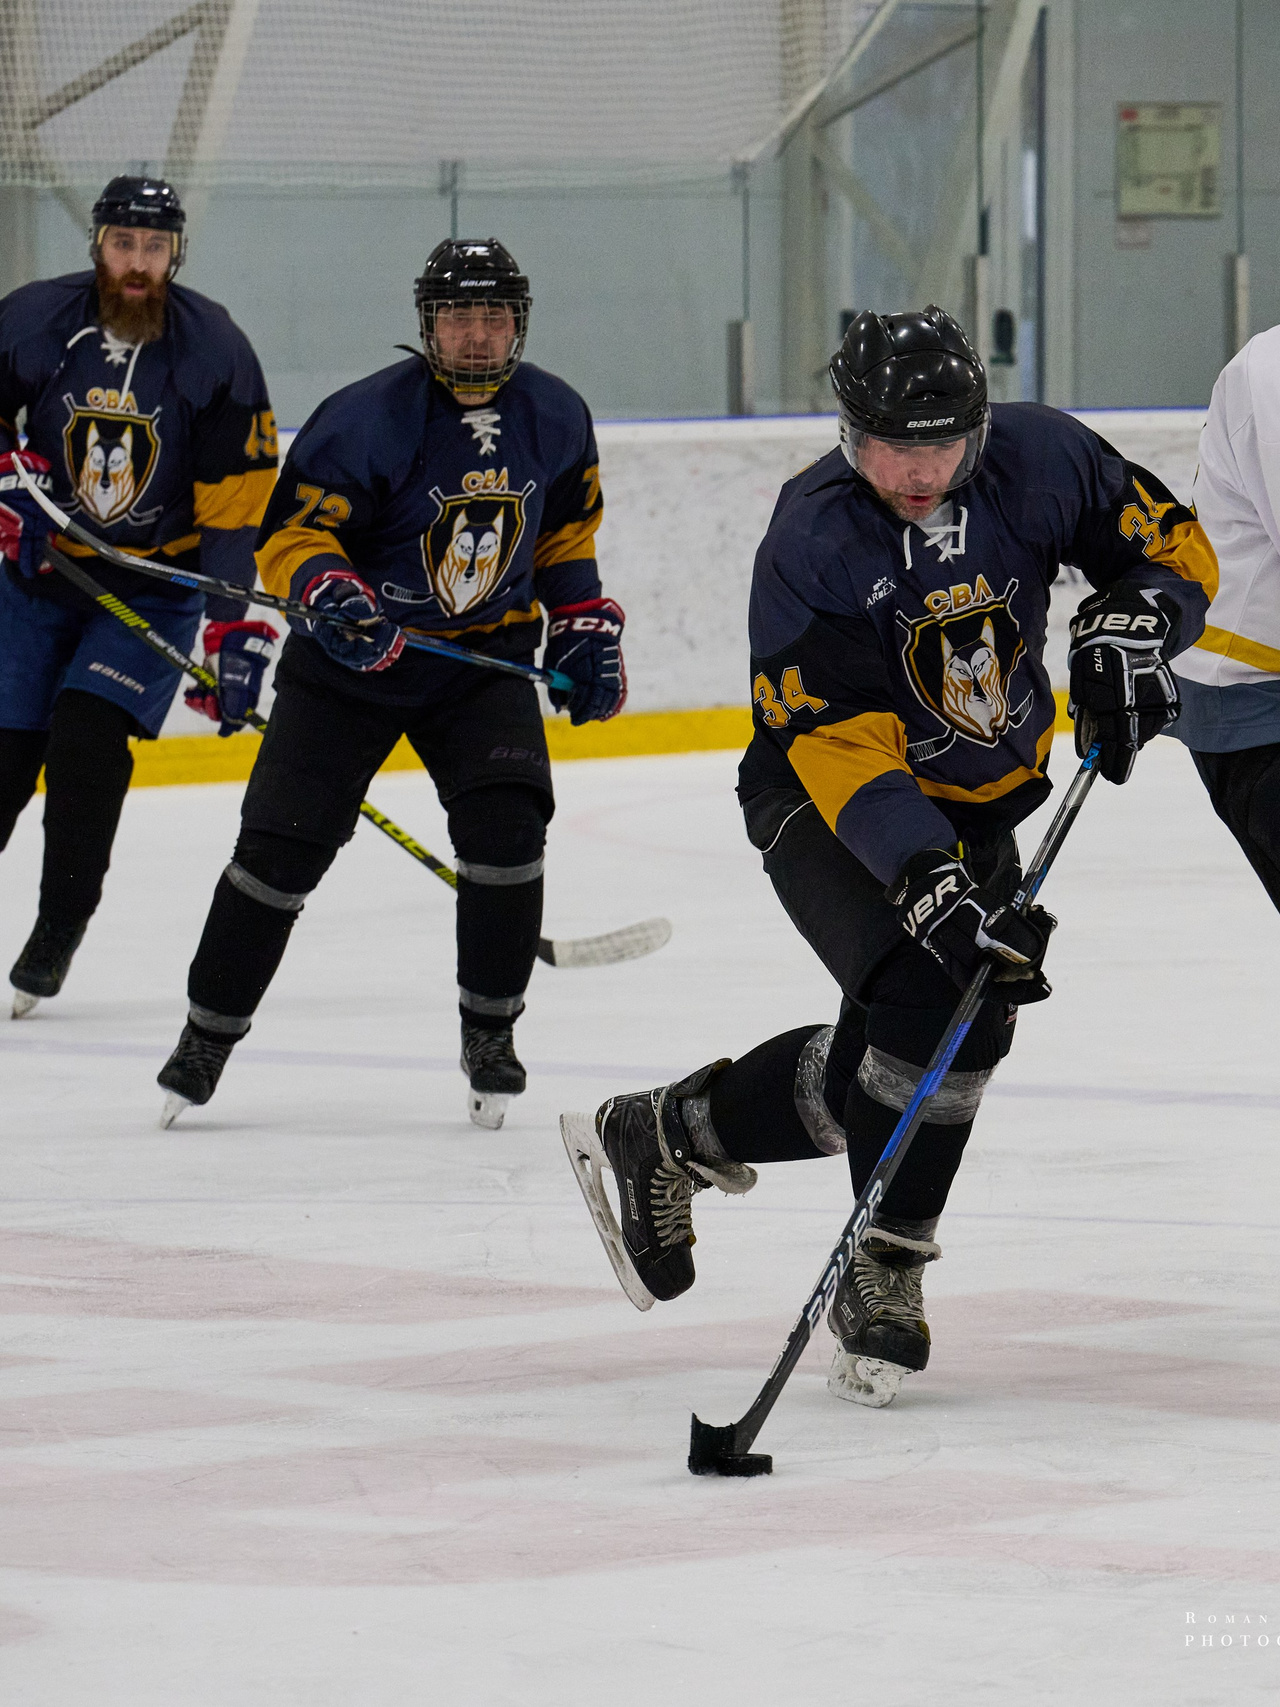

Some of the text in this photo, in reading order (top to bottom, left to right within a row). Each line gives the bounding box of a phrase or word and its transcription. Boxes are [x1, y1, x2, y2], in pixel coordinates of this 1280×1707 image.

[459, 280, 497, 288] BAUER
[906, 417, 955, 429] BAUER
[283, 483, 352, 528] 72
[549, 617, 621, 637] CCM
[88, 661, 146, 695] BAUER
[753, 665, 830, 729] 34
[806, 1178, 883, 1337] BAUER
